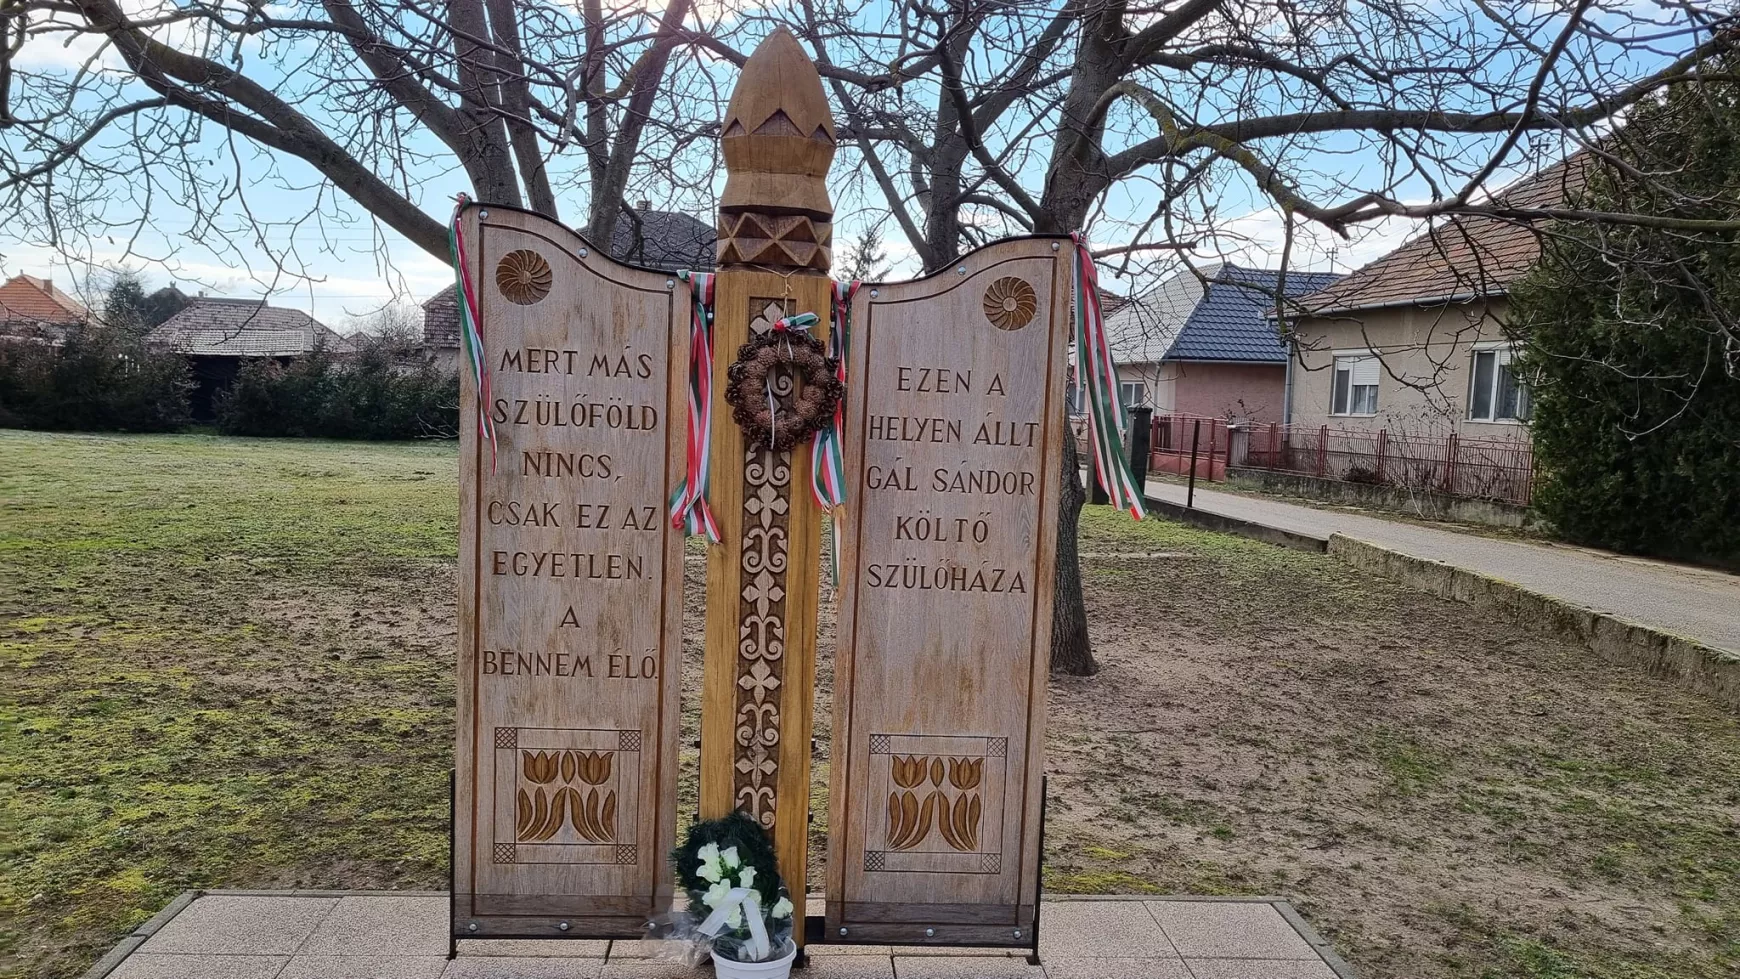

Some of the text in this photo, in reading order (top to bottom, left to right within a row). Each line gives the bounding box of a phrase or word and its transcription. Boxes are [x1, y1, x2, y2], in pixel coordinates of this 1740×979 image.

[499, 346, 652, 379] MERT MÁS
[897, 366, 1006, 396] EZEN A
[492, 394, 658, 431] SZÜLŐFÖLD
[869, 412, 1039, 447] HELYEN ÁLLT
[522, 451, 624, 483] NINCS,
[867, 457, 1035, 496] GÁL SÁNDOR
[487, 500, 658, 531] CSAK EZ AZ
[895, 510, 991, 544] KÖLTŐ
[492, 551, 652, 580] EGYETLEN.
[867, 557, 1027, 594] SZÜLŐHÁZA
[559, 605, 581, 628] A
[482, 648, 658, 679] BENNEM ÉLŐ.
